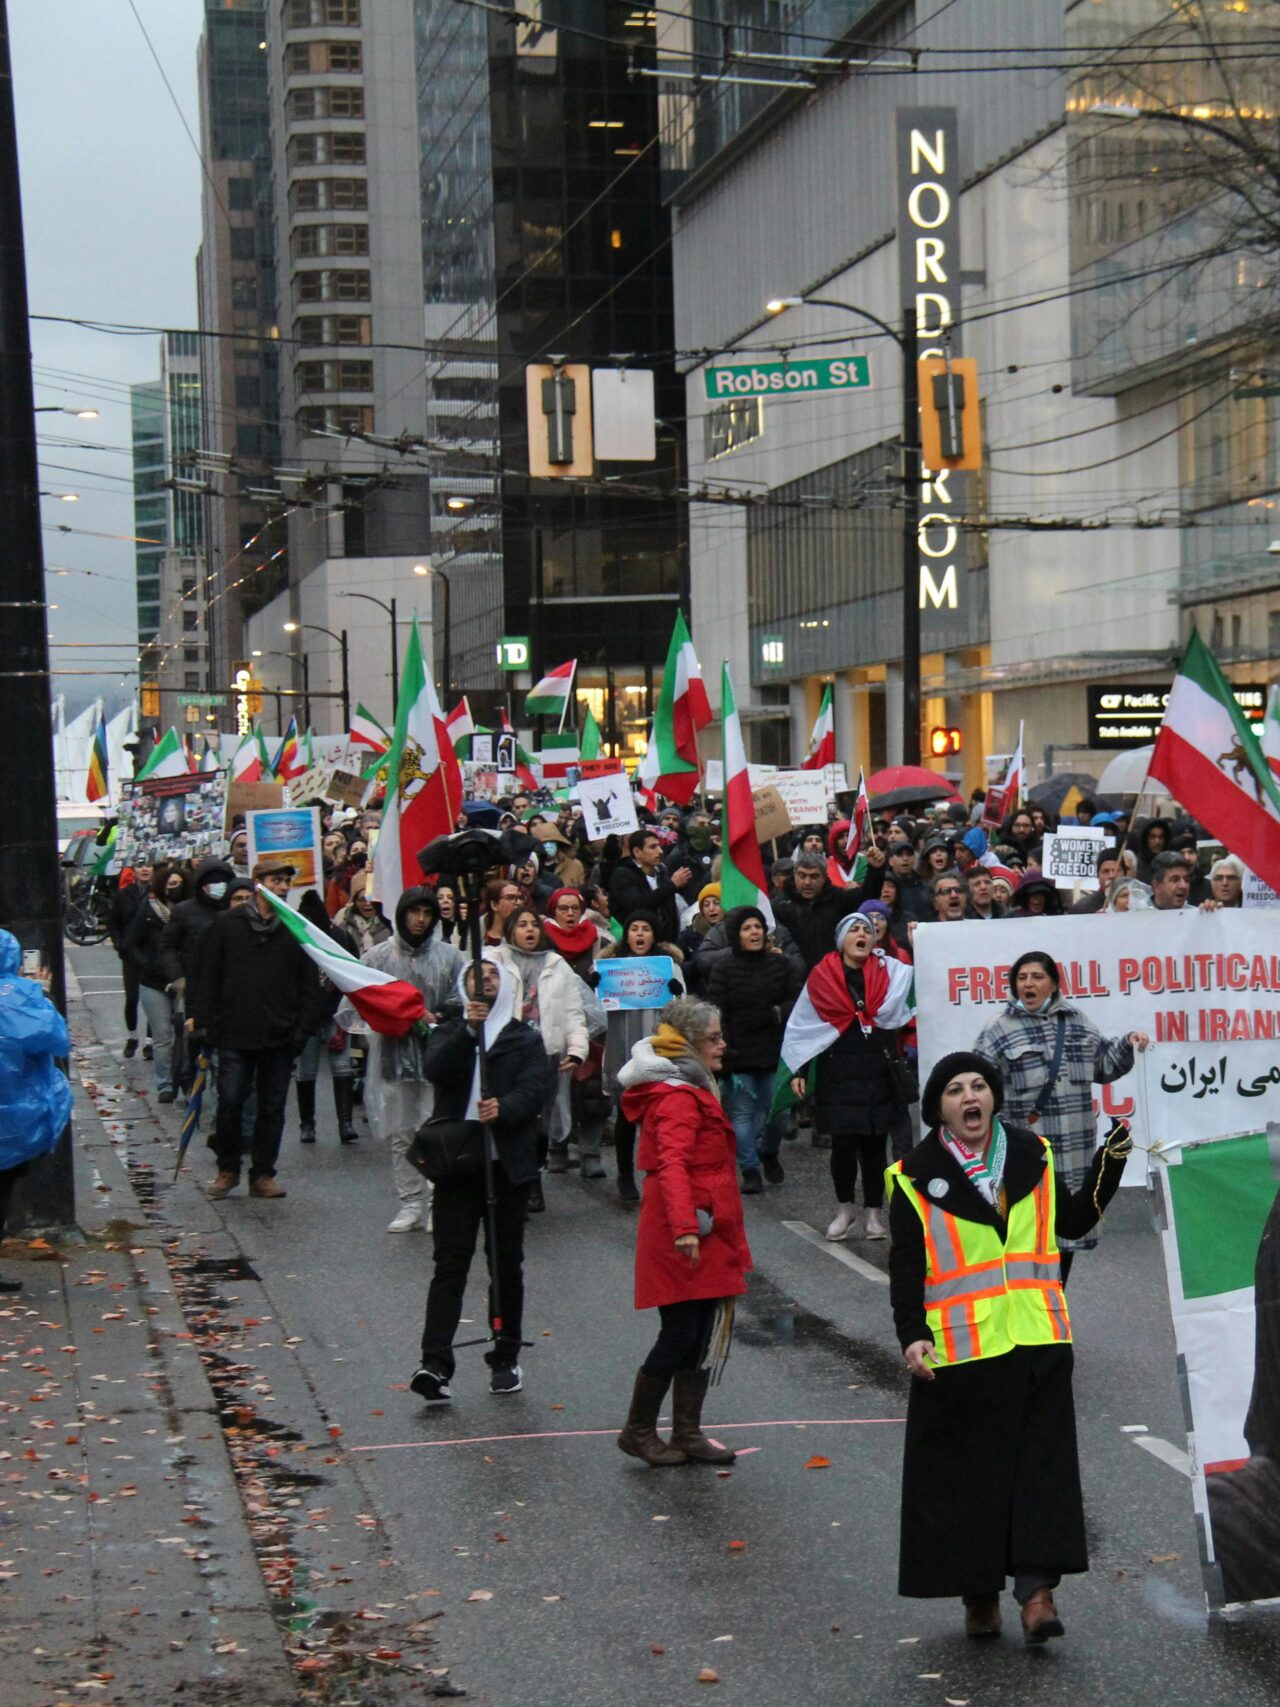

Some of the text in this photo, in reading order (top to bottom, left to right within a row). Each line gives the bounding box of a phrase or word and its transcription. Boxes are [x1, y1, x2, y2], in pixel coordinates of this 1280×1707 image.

[715, 361, 859, 394] Robson St
[908, 128, 958, 609] NORDROM
[503, 643, 527, 664] TD
[1124, 693, 1159, 707] Pacific
[1060, 839, 1100, 851] WOMEN
[1067, 852, 1091, 864] LIFE
[1051, 863, 1098, 877] FREEDO
[948, 965, 1012, 1005] FRE
[1155, 1010, 1189, 1042] IN
[1160, 1055, 1228, 1099] ایران
